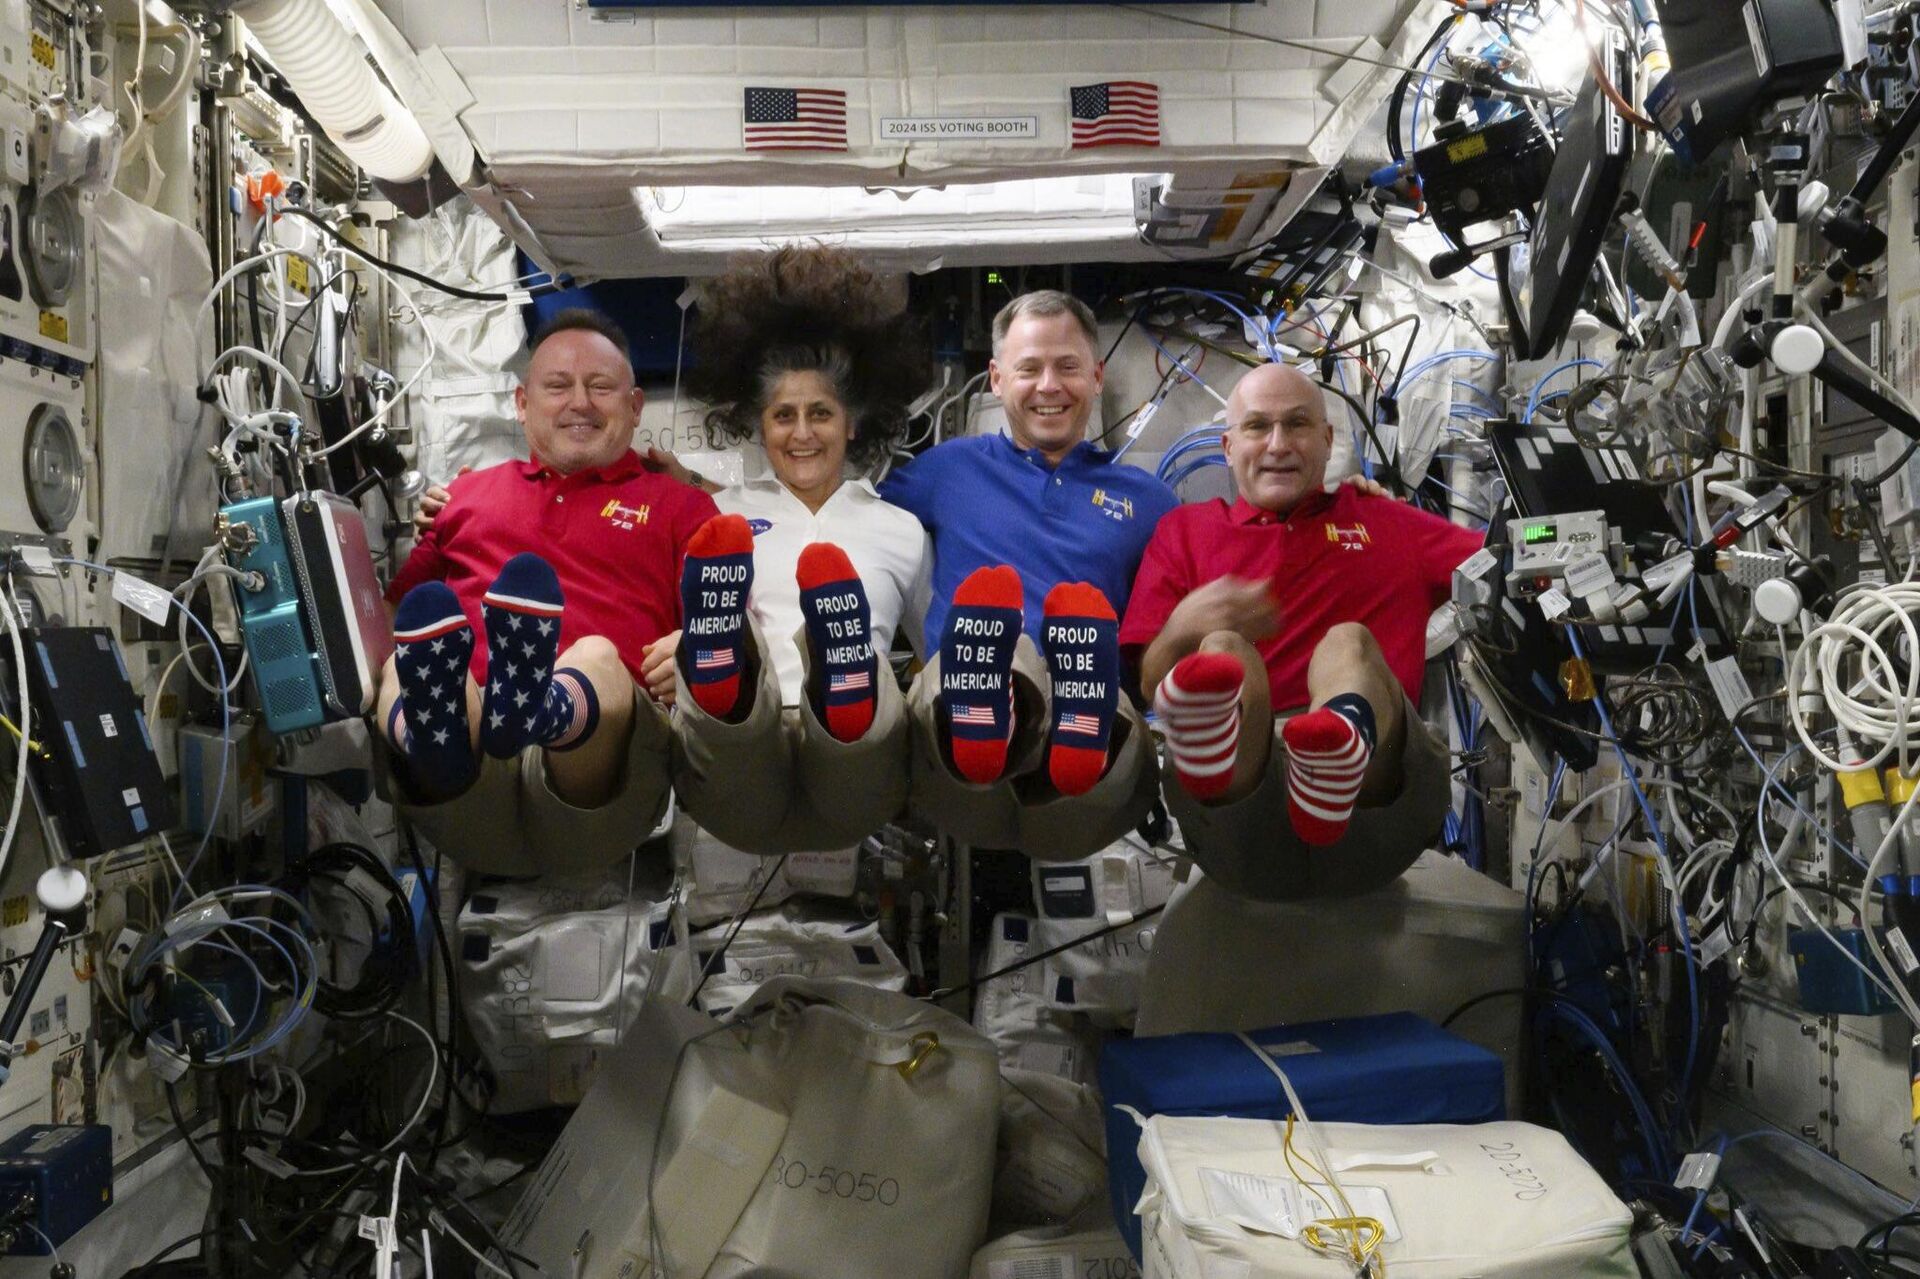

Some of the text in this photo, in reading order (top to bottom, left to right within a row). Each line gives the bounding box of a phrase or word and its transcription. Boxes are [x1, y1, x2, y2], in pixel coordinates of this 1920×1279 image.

[889, 121, 1028, 133] 2024 ISS VOTING BOOTH
[1103, 507, 1124, 521] 72
[1341, 542, 1364, 551] 72
[701, 565, 747, 583] PROUD
[701, 591, 739, 608] TO BE
[815, 593, 859, 615] PROUD
[688, 613, 743, 635] AMERICAN
[826, 618, 864, 639] TO BE
[954, 617, 1004, 637] PROUD
[1048, 626, 1098, 644] PROUD
[955, 644, 996, 664] TO BE
[1056, 653, 1094, 671] TO BE
[943, 673, 1001, 690] AMERICAN
[1054, 681, 1106, 700] AMERICAN
